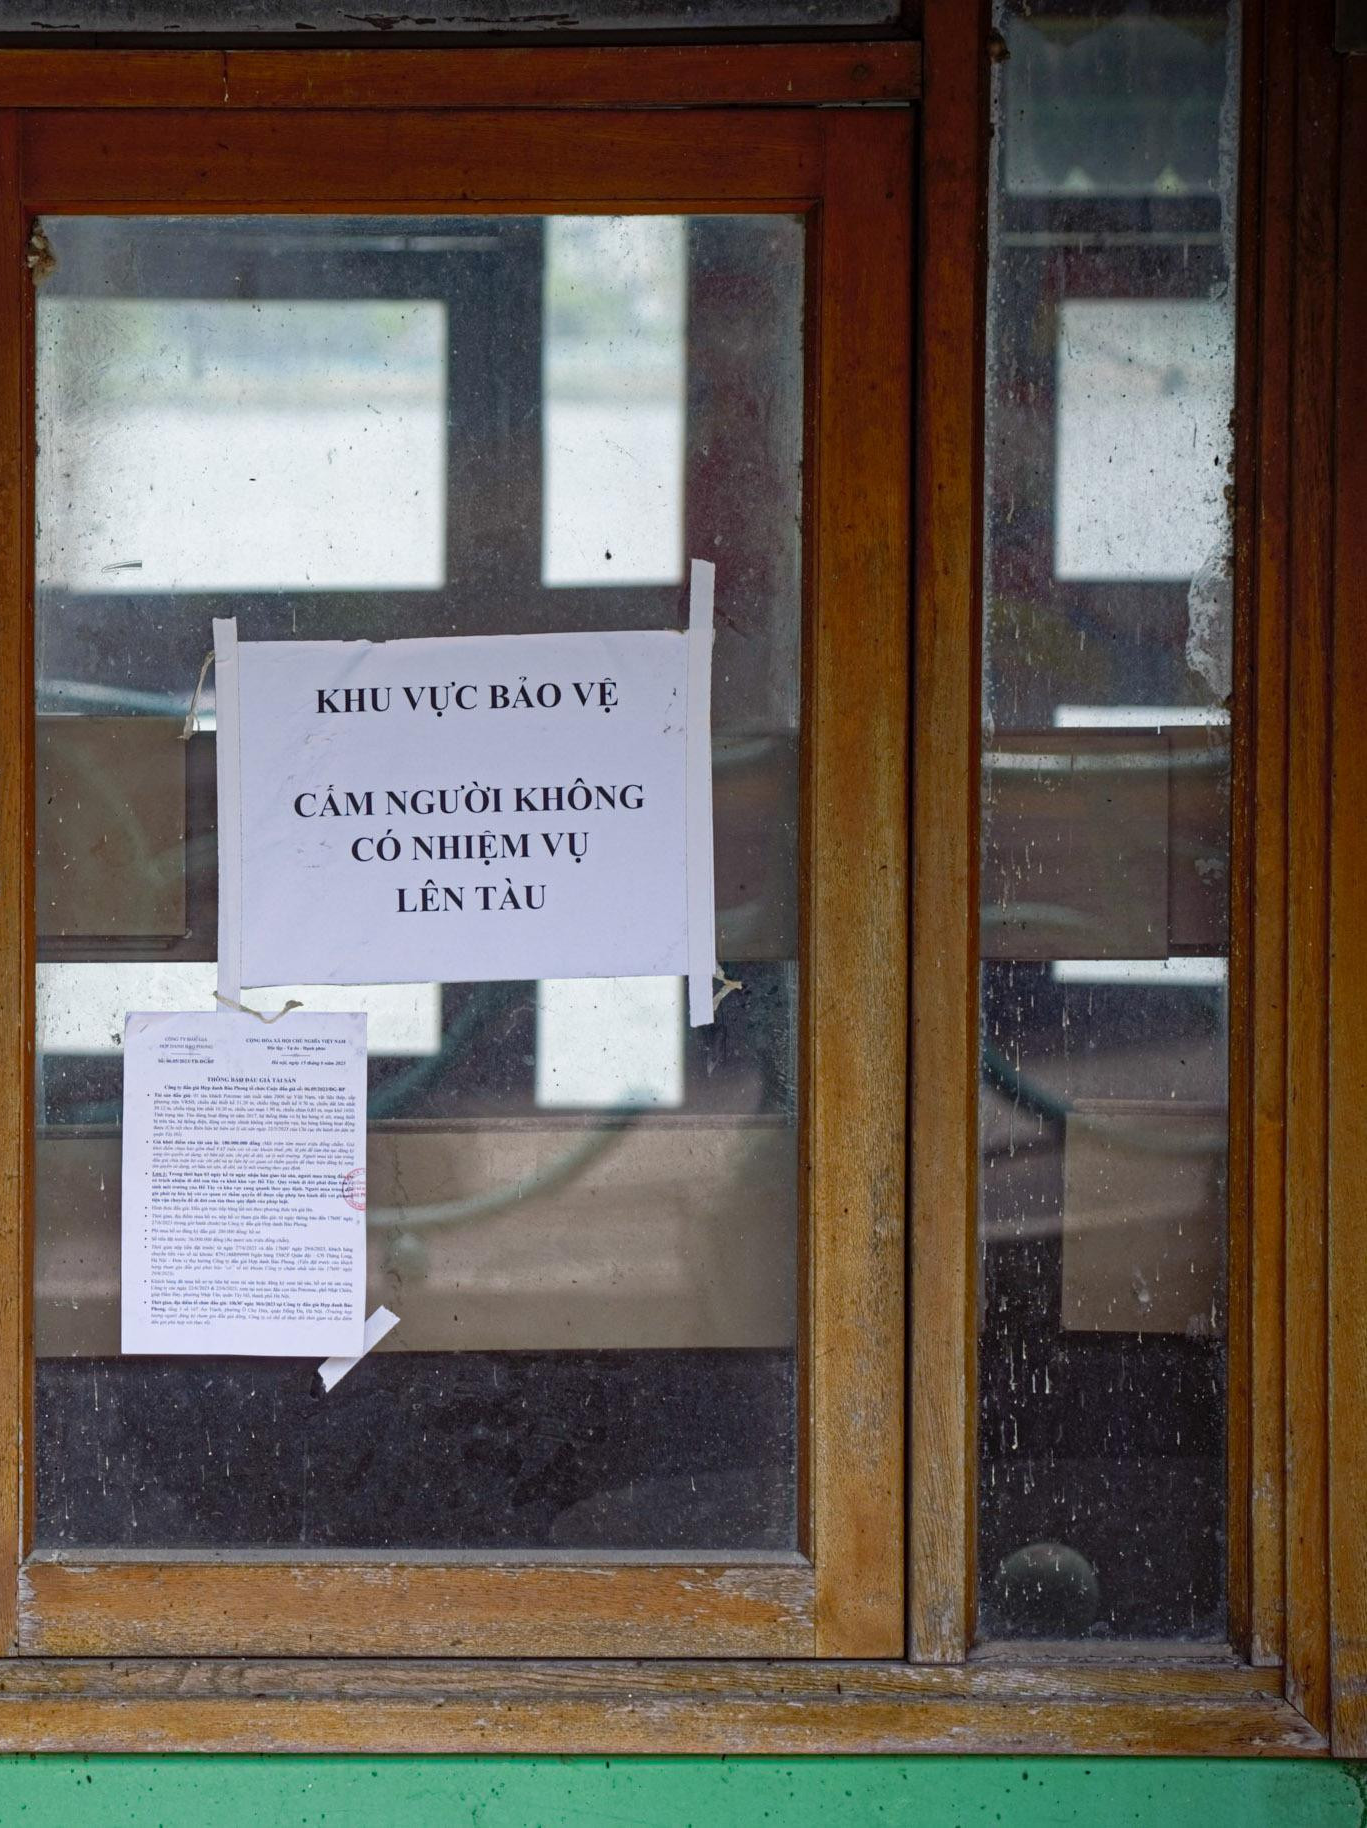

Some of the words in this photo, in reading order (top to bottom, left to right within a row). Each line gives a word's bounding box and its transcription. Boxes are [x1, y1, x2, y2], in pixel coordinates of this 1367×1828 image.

[315, 687, 392, 714] KHU
[403, 681, 478, 718] VỰC
[489, 676, 562, 710] BẢO
[571, 677, 619, 714] VỆ
[293, 783, 374, 818] CẤM
[385, 781, 502, 815] NGƯỜI
[514, 777, 644, 812] KHÔNG
[351, 829, 402, 862] CÓ
[411, 829, 530, 866] NHIỆM
[541, 831, 589, 864] VỤ
[397, 879, 465, 913] LÊN
[474, 877, 546, 911] TÀU
